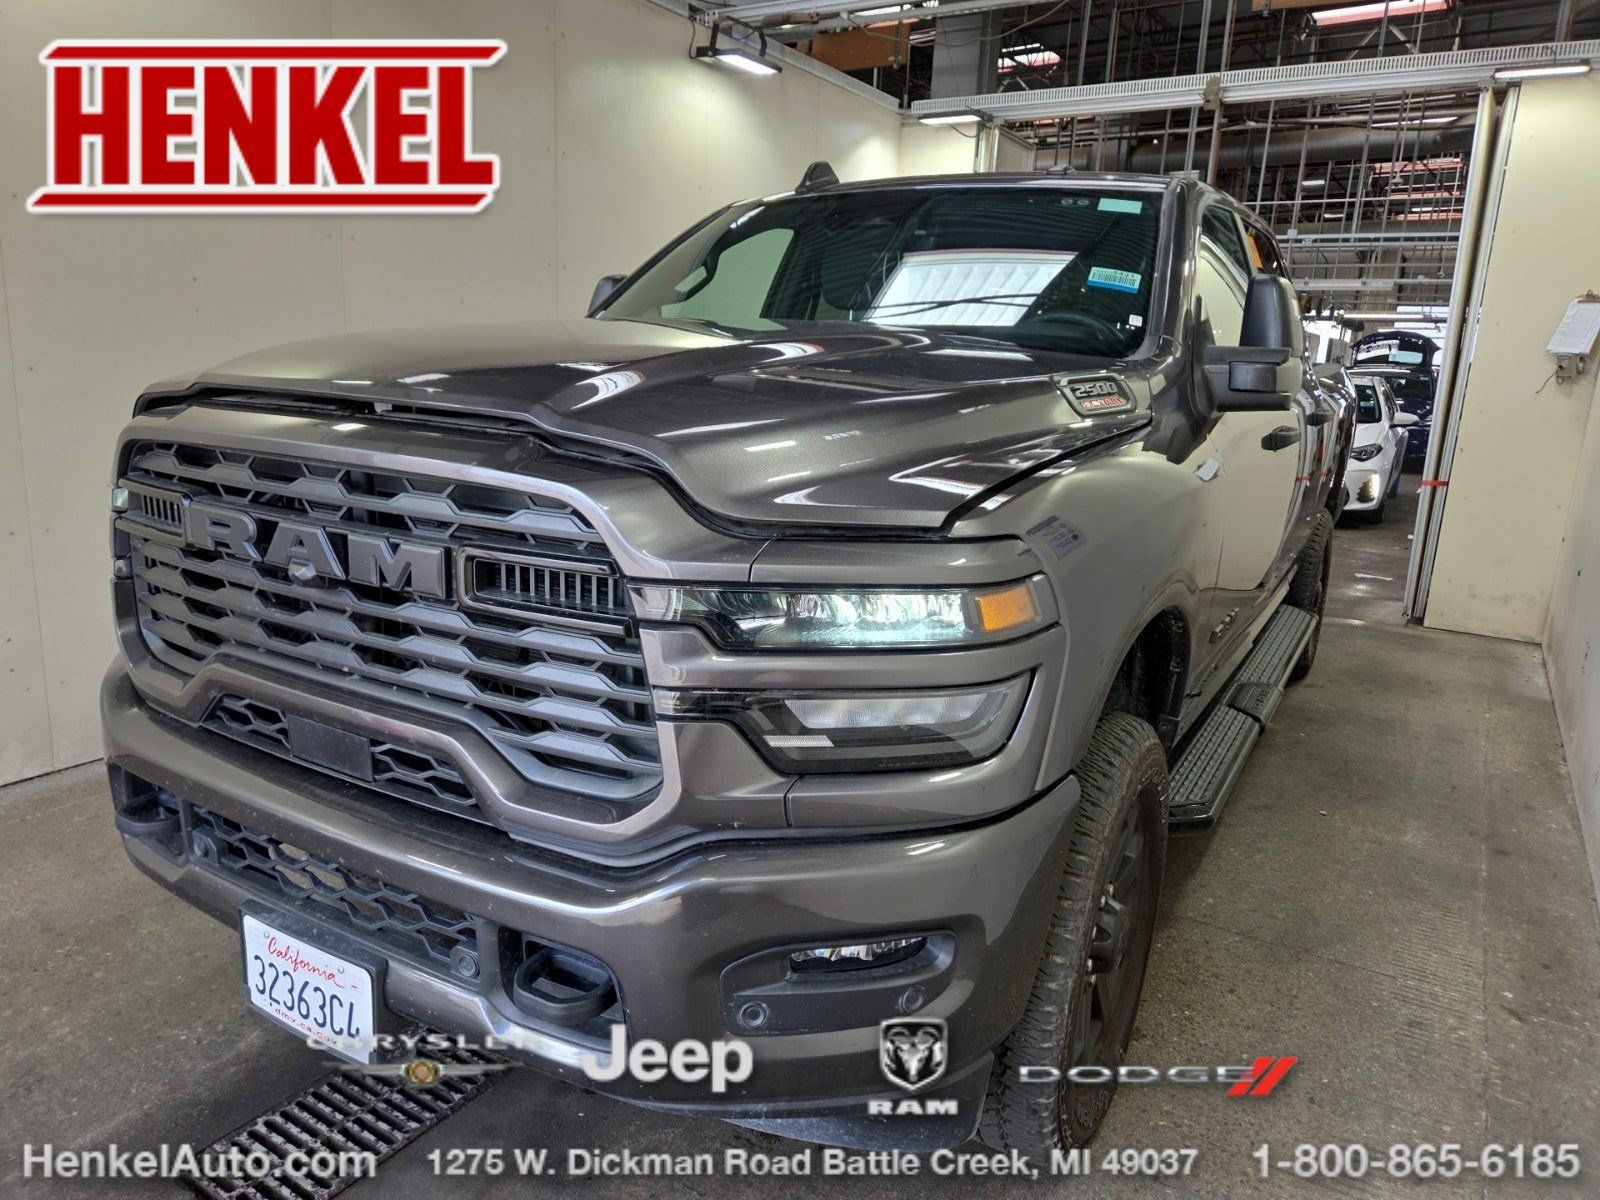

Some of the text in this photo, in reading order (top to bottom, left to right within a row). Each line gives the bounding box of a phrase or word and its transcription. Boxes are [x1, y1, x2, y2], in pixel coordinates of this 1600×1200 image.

[1074, 381, 1118, 398] 2500
[189, 499, 445, 599] RAM
[267, 936, 345, 989] California
